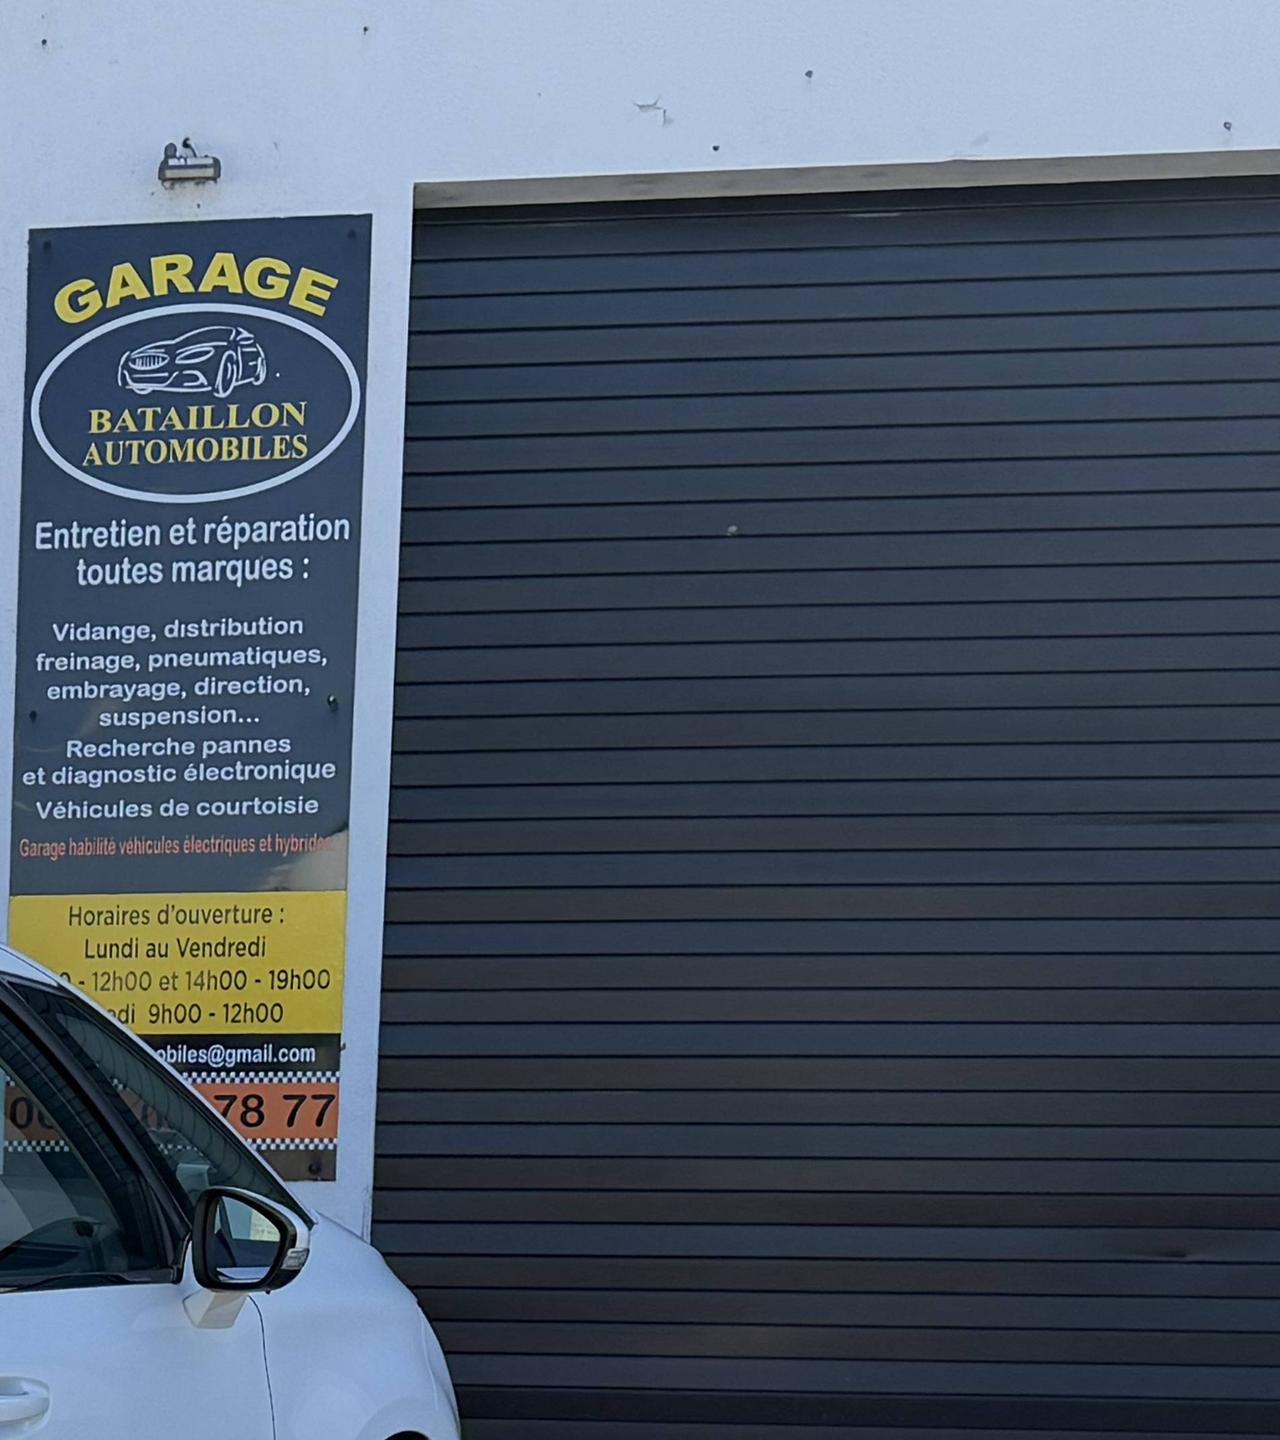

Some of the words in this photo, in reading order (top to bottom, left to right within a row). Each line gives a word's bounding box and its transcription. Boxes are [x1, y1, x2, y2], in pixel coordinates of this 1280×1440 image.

[54, 252, 339, 324] GARAGE
[88, 401, 308, 434] BATAILLON
[82, 434, 308, 467] AUTOMOBILES
[35, 518, 161, 550] Entretien
[169, 518, 196, 546] et
[203, 513, 350, 550] réparation
[77, 558, 163, 586] toutes
[172, 557, 293, 587] marques
[52, 622, 157, 643] Vidange,
[164, 616, 304, 639] distribution
[36, 652, 140, 673] freinage,
[148, 647, 328, 672] pneumatiques,
[47, 680, 187, 702] embrayage,
[194, 676, 310, 696] direction,
[99, 706, 260, 729] suspension...
[66, 738, 196, 758] Recherche
[202, 737, 291, 758] pannes
[23, 768, 46, 785] et
[52, 764, 177, 788] diagnostic
[183, 760, 336, 784] électronique
[36, 799, 153, 819] Véhicules
[159, 798, 190, 816] de
[196, 796, 320, 816] courtoisie
[19, 838, 66, 861] Garage
[259, 834, 273, 852] et
[68, 904, 150, 927] Horaires
[156, 904, 273, 925] d'ouverture
[84, 938, 139, 959] Lundi
[145, 943, 169, 959] au
[176, 936, 267, 958] Vendredi
[92, 970, 152, 992] 12h00
[159, 973, 179, 991] et
[185, 969, 247, 991] 14h00
[268, 968, 331, 990] 19h00
[148, 1002, 202, 1025] 9h00
[223, 1002, 284, 1024] 12h00
[156, 1044, 316, 1068] obiles@gmail.com
[214, 1094, 265, 1129] 78
[282, 1093, 337, 1128] 77
